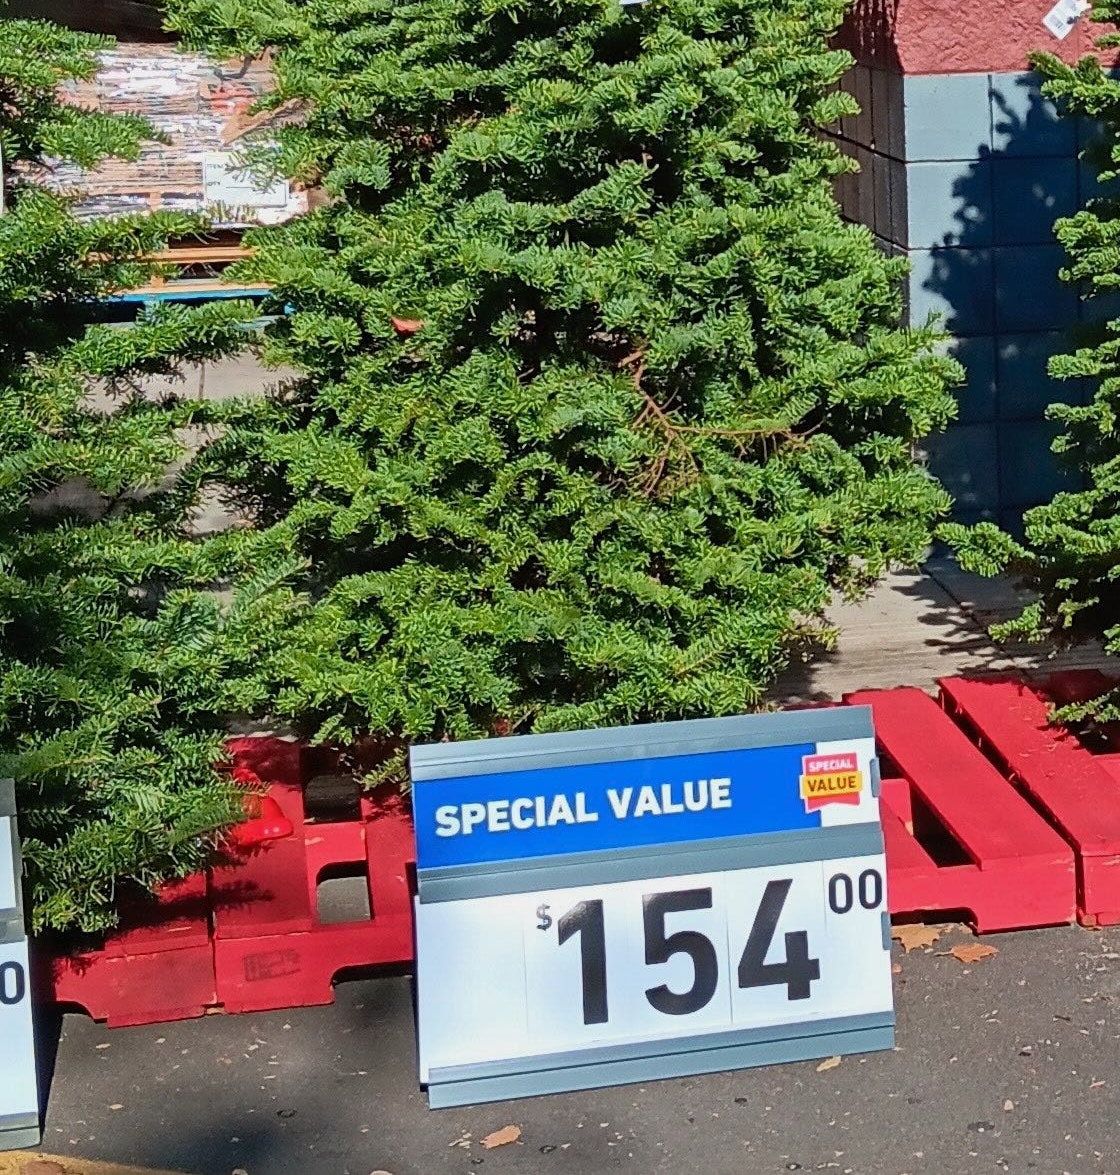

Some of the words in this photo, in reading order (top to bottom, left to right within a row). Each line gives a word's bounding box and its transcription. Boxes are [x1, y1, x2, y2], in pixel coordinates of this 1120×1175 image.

[807, 757, 855, 774] SPECIAL
[806, 775, 857, 793] VALUE
[435, 792, 599, 837] SPECIAL
[606, 777, 733, 820] VALUE
